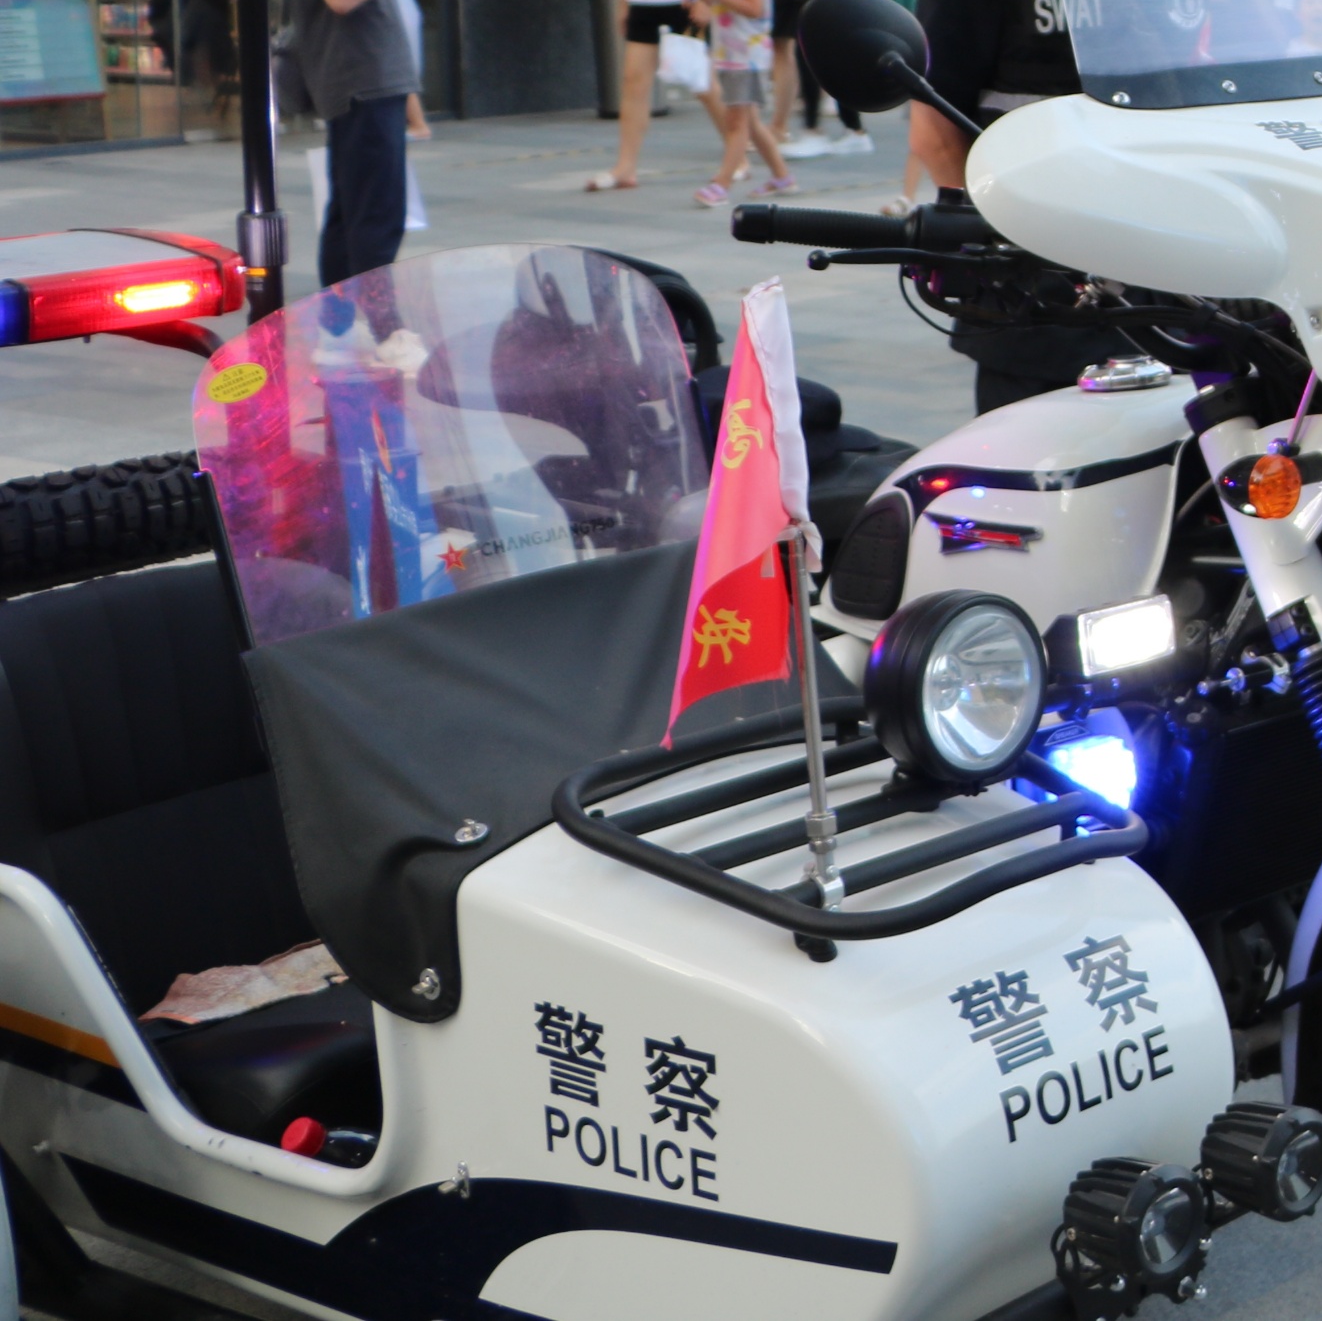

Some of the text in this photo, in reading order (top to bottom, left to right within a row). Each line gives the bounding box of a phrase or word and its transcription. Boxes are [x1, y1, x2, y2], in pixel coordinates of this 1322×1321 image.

[948, 934, 1159, 1076] 警察
[533, 1000, 720, 1141] 警察
[999, 1024, 1174, 1144] POLICE
[544, 1104, 720, 1202] POLICE
